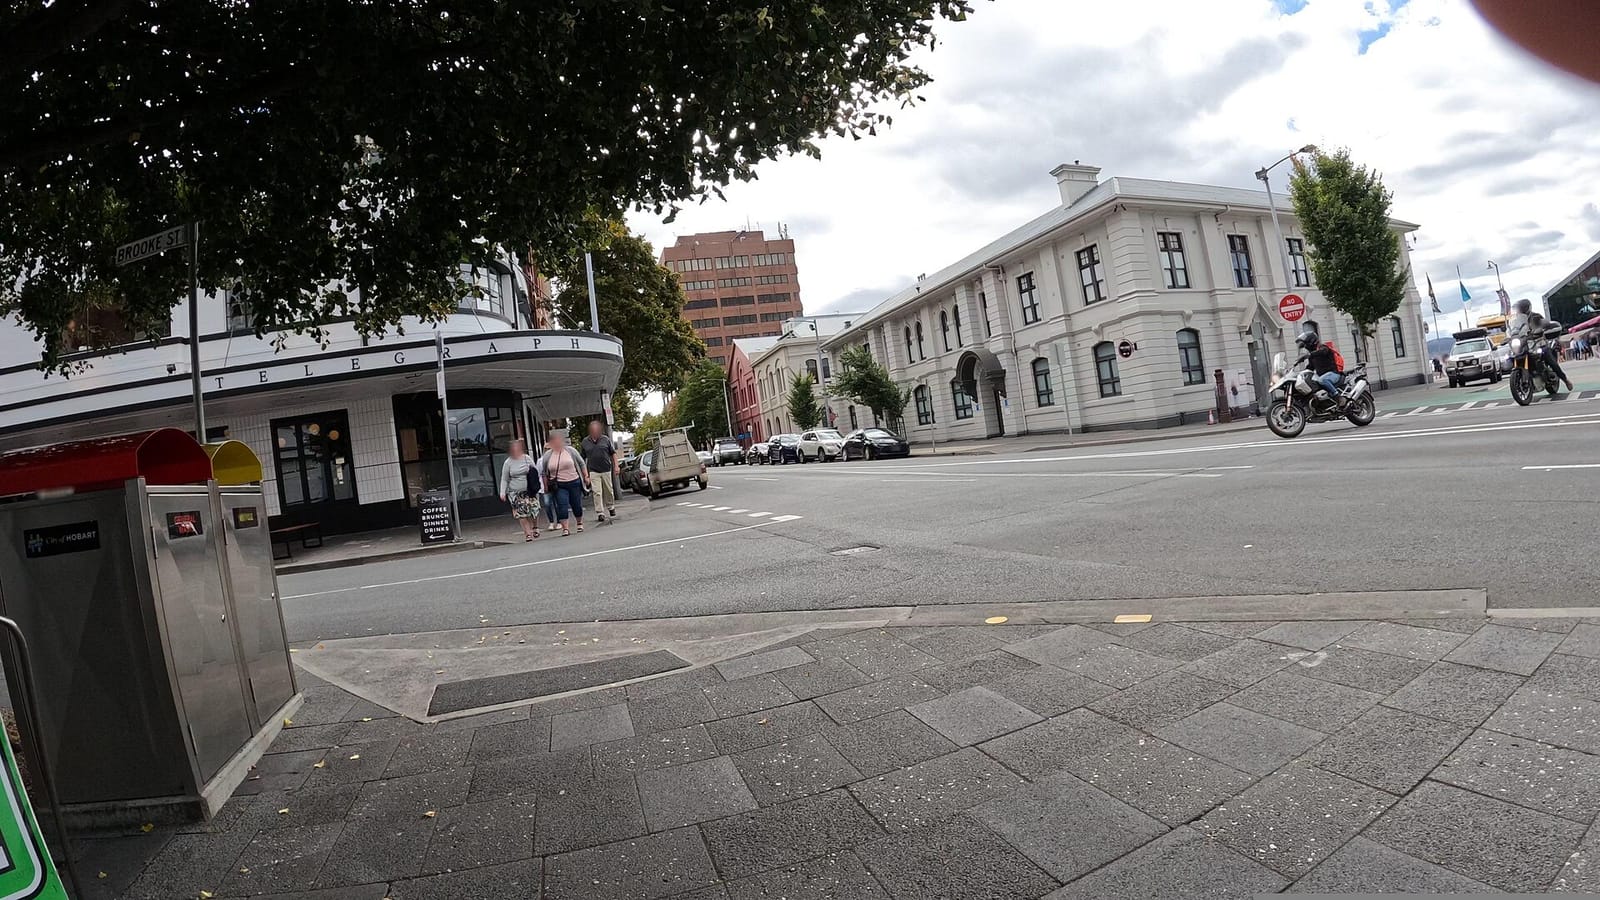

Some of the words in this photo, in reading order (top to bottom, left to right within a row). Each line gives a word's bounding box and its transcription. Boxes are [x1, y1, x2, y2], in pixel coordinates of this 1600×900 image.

[118, 236, 163, 262] BROOKE
[166, 230, 183, 245] ST
[1284, 310, 1303, 319] ENTRY
[214, 337, 580, 389] TELEGRAPH
[422, 506, 447, 514] COFFEE
[421, 513, 449, 521] BRUNCH
[423, 519, 449, 527] DINNER
[424, 526, 450, 534] DRINKS
[66, 531, 97, 542] HOBART
